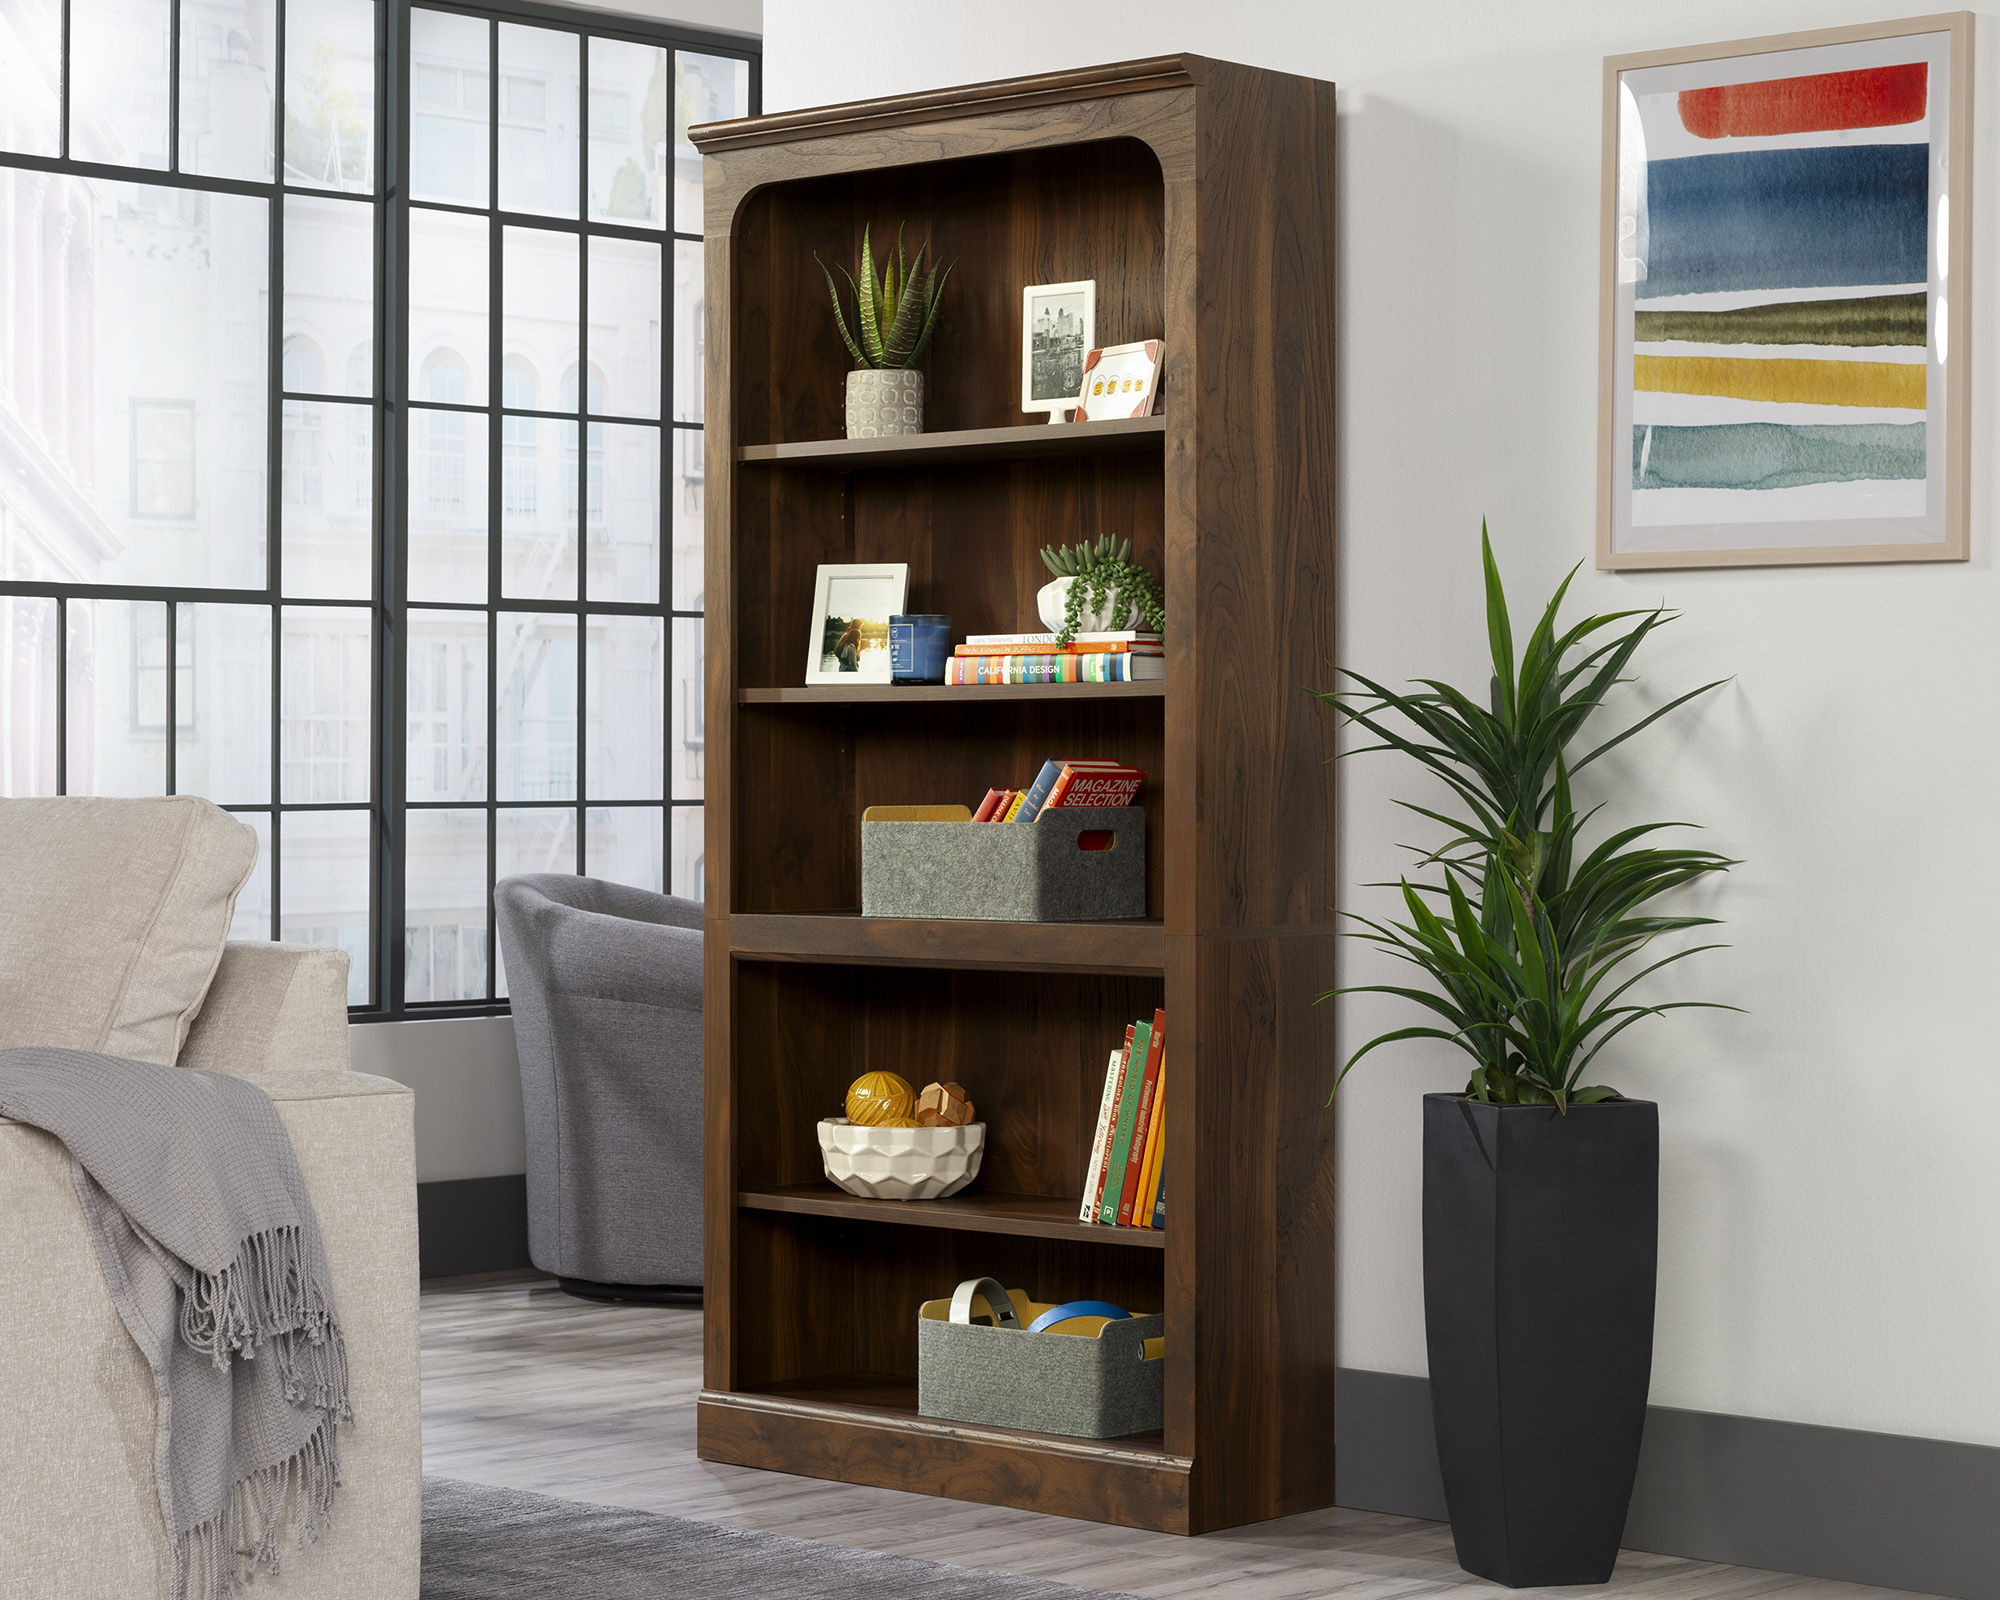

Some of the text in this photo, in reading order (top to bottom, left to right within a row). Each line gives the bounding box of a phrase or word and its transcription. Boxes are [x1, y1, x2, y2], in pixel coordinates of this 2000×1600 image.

[1023, 634, 1058, 644] LONDO
[1029, 665, 1060, 674] DESIGN
[1070, 779, 1141, 793] MAGAZINE
[1063, 793, 1132, 806] SELECTION
[1105, 1060, 1117, 1102] MASTERING
[1129, 1060, 1141, 1092] WORLD
[1115, 1075, 1123, 1101] GOLDEN
[1127, 1094, 1134, 1106] OF
[1111, 1103, 1119, 1122] BOOK
[1120, 1111, 1131, 1143] WHISKY
[1101, 1124, 1115, 1172] ENCYCLOPEDIA
